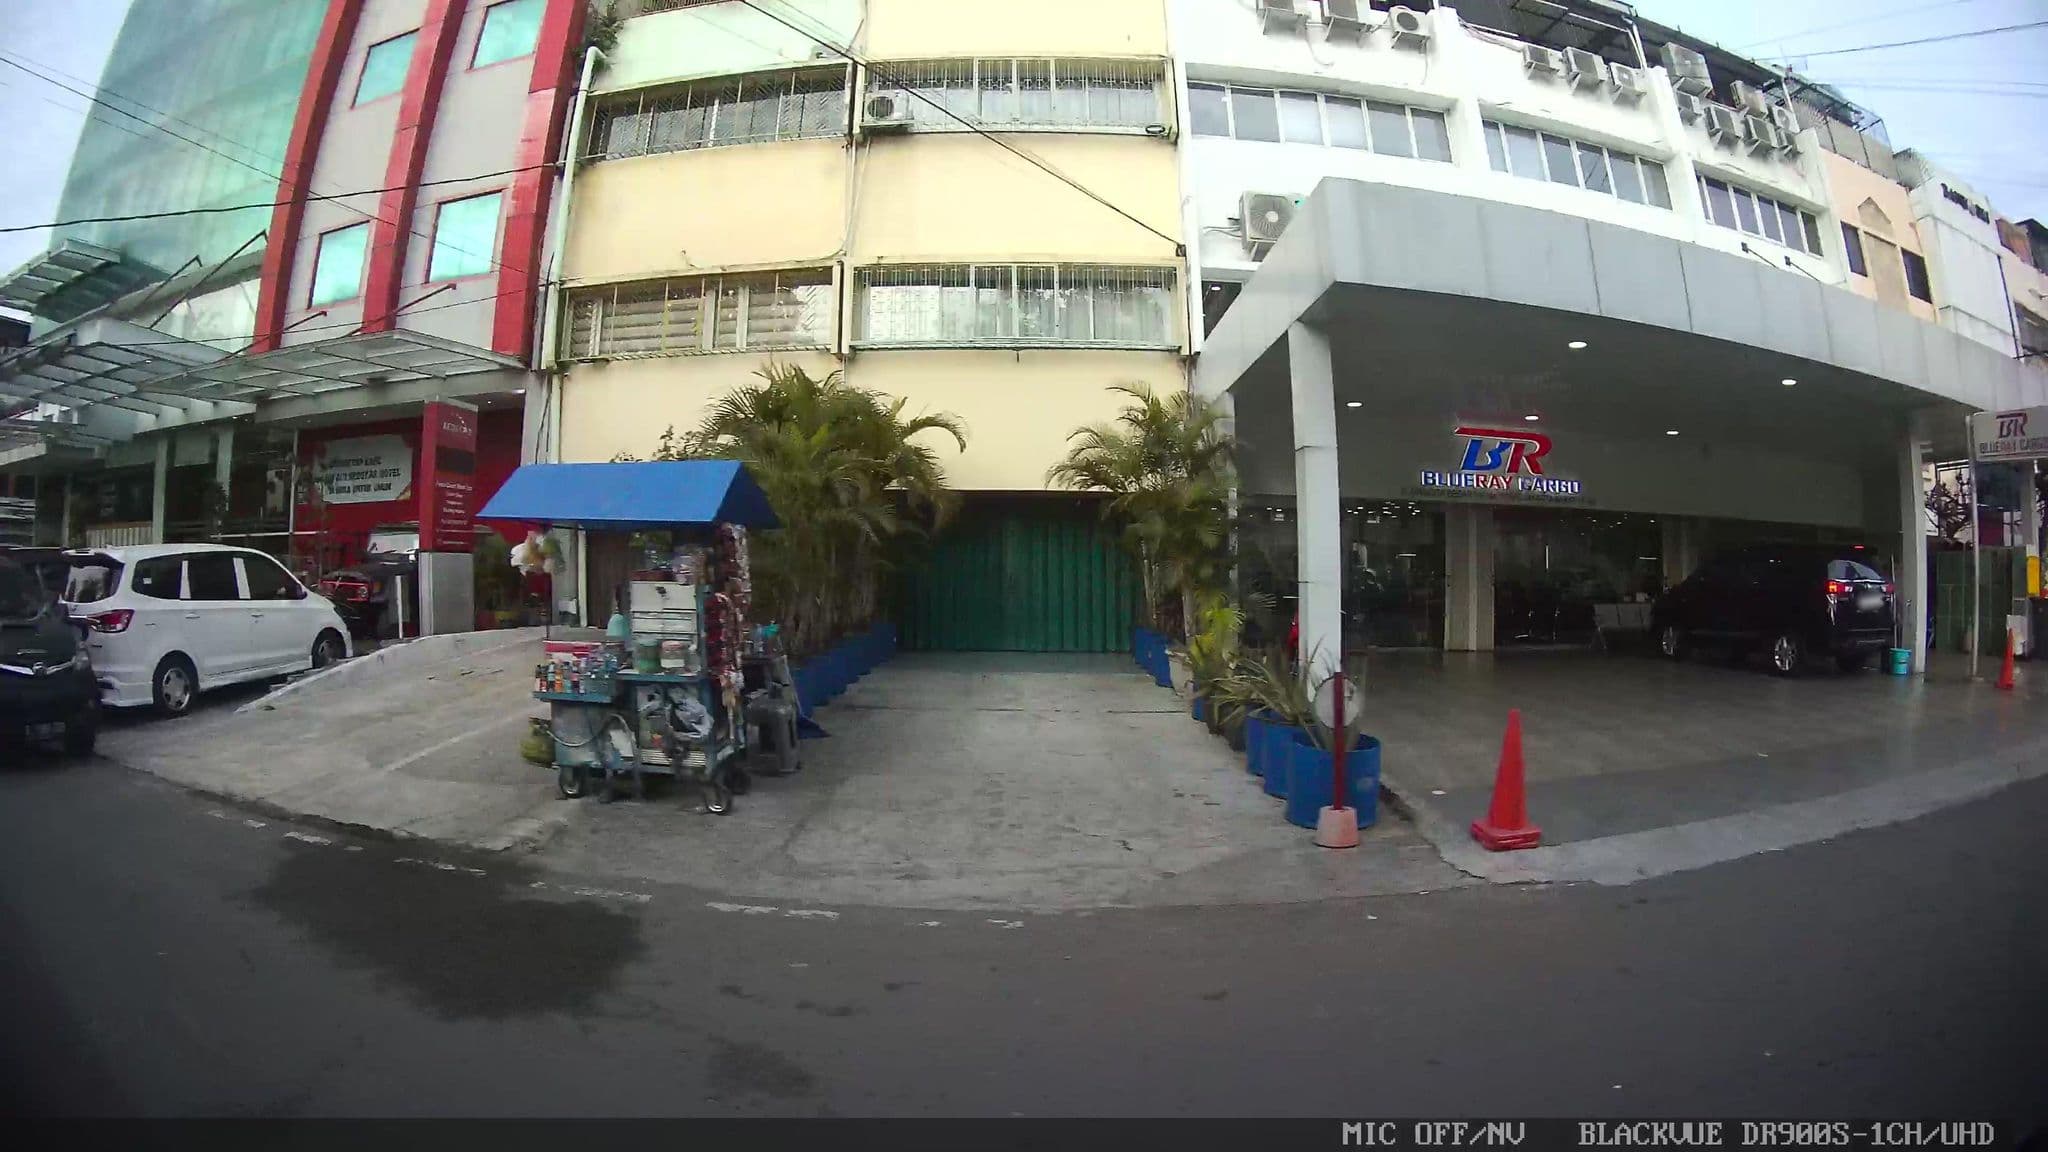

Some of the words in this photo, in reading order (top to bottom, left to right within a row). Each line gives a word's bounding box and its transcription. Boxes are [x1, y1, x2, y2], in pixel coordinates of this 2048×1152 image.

[1454, 427, 1552, 476] BR
[1421, 470, 1513, 490] BLUERAY
[1518, 477, 1582, 494] CARGO
